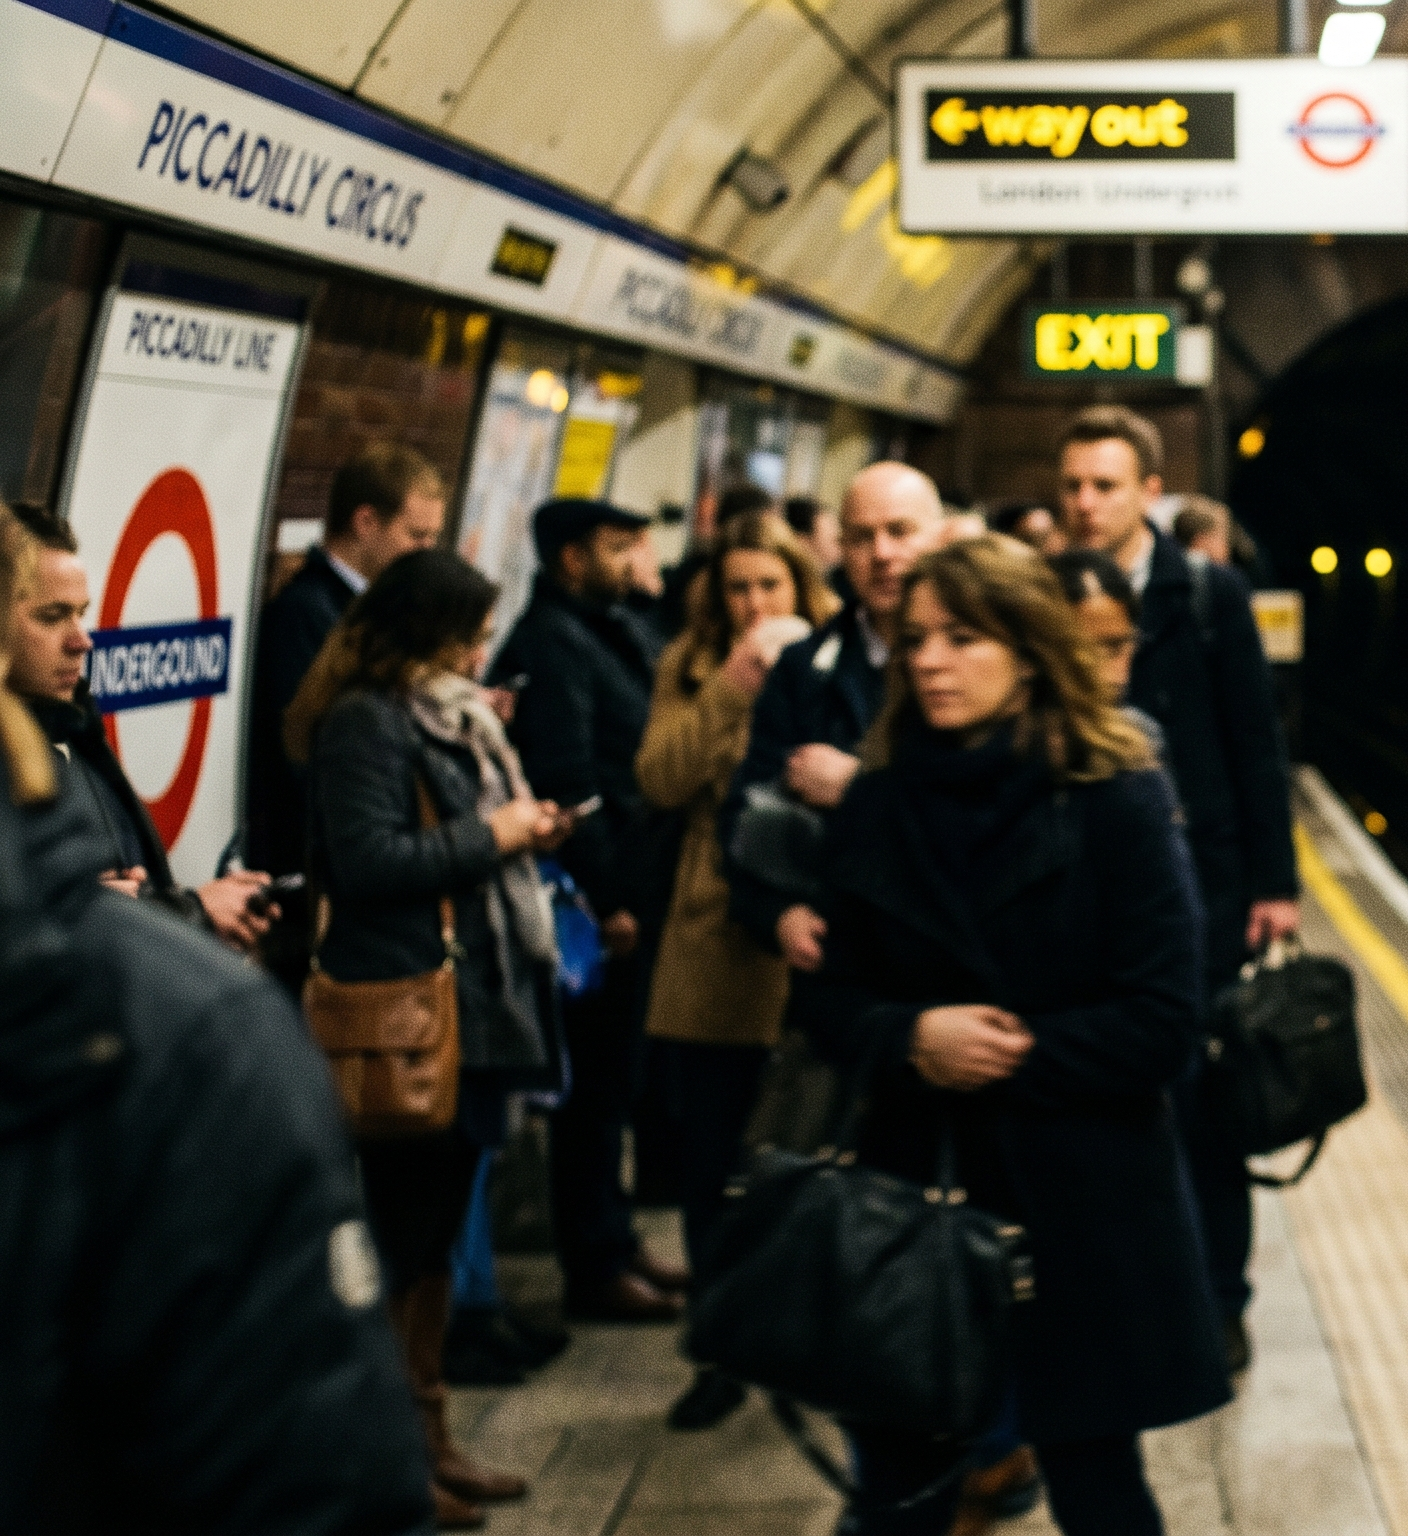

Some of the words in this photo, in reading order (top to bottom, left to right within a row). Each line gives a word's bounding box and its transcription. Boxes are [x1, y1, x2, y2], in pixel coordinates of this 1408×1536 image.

[979, 104, 1091, 159] way
[1090, 98, 1190, 148] out
[137, 99, 329, 216] PICCADILLY
[325, 164, 425, 249] CIRCUS
[124, 310, 233, 364] PICCADILLY
[232, 328, 277, 372] LINE
[1035, 313, 1170, 371] EXIT
